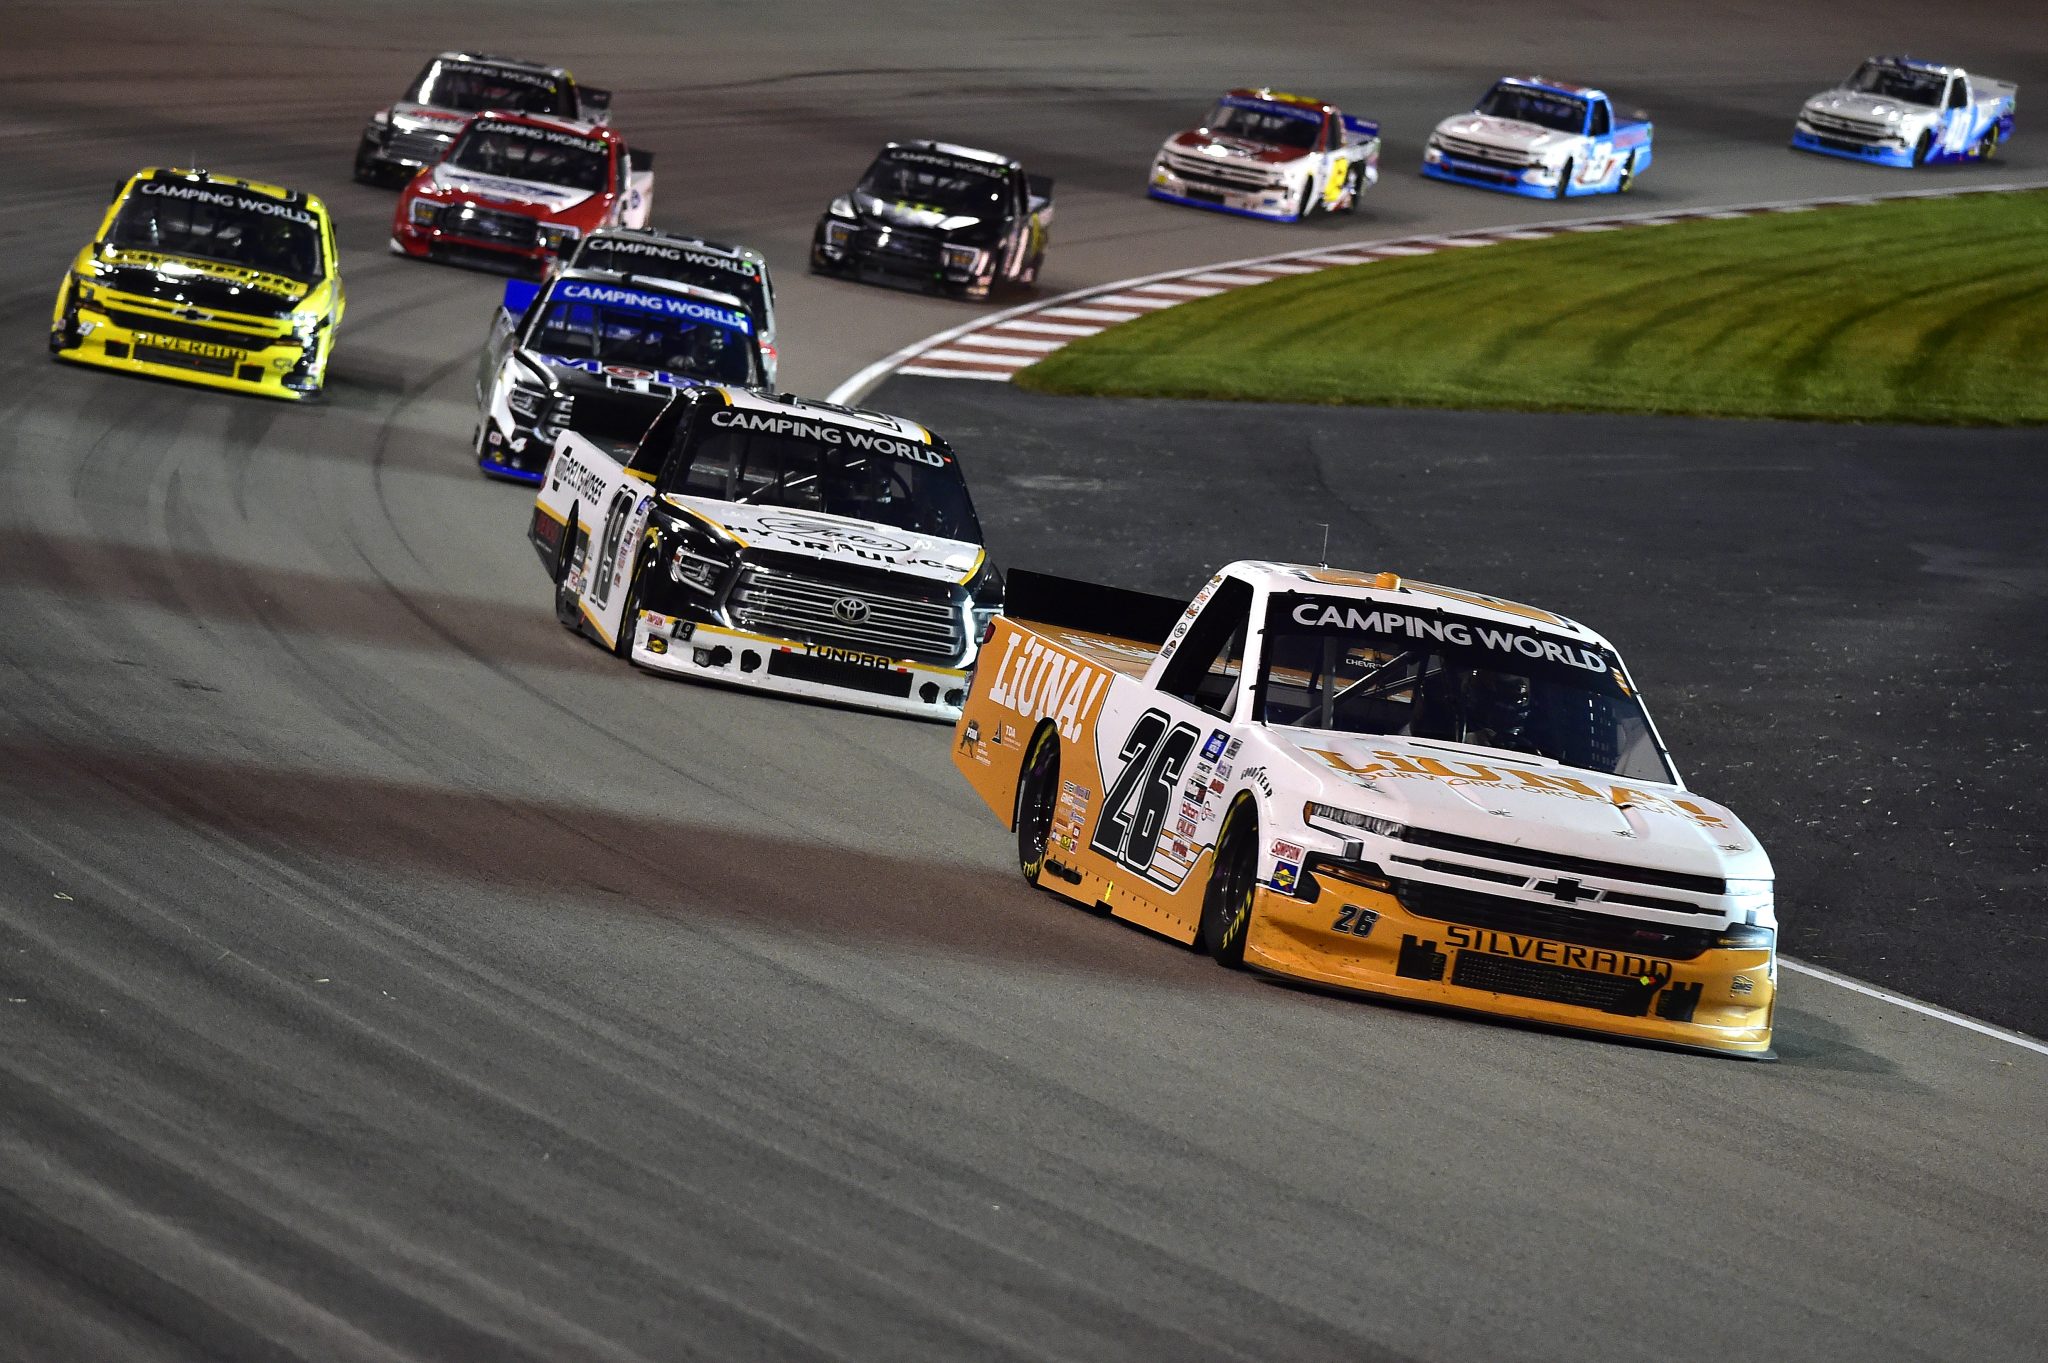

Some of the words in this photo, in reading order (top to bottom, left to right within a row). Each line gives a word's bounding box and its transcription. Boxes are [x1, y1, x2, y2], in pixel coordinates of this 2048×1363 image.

[475, 121, 543, 140] CAMPING
[546, 132, 601, 153] WORLD
[140, 182, 234, 208] CAMPING
[237, 197, 311, 223] WORLD
[588, 239, 682, 262] CAMPING
[685, 252, 756, 277] WORLD
[563, 285, 663, 310] CAMPING
[666, 299, 744, 325] WORLD
[711, 411, 842, 445] CAMPING
[849, 433, 946, 468] WORLD
[670, 619, 697, 643] 19
[1291, 603, 1473, 646] CAMPING
[1475, 626, 1608, 673] WORLD
[803, 641, 890, 670] TUNDRA
[1088, 707, 1201, 873] 26
[1330, 903, 1380, 939] 26
